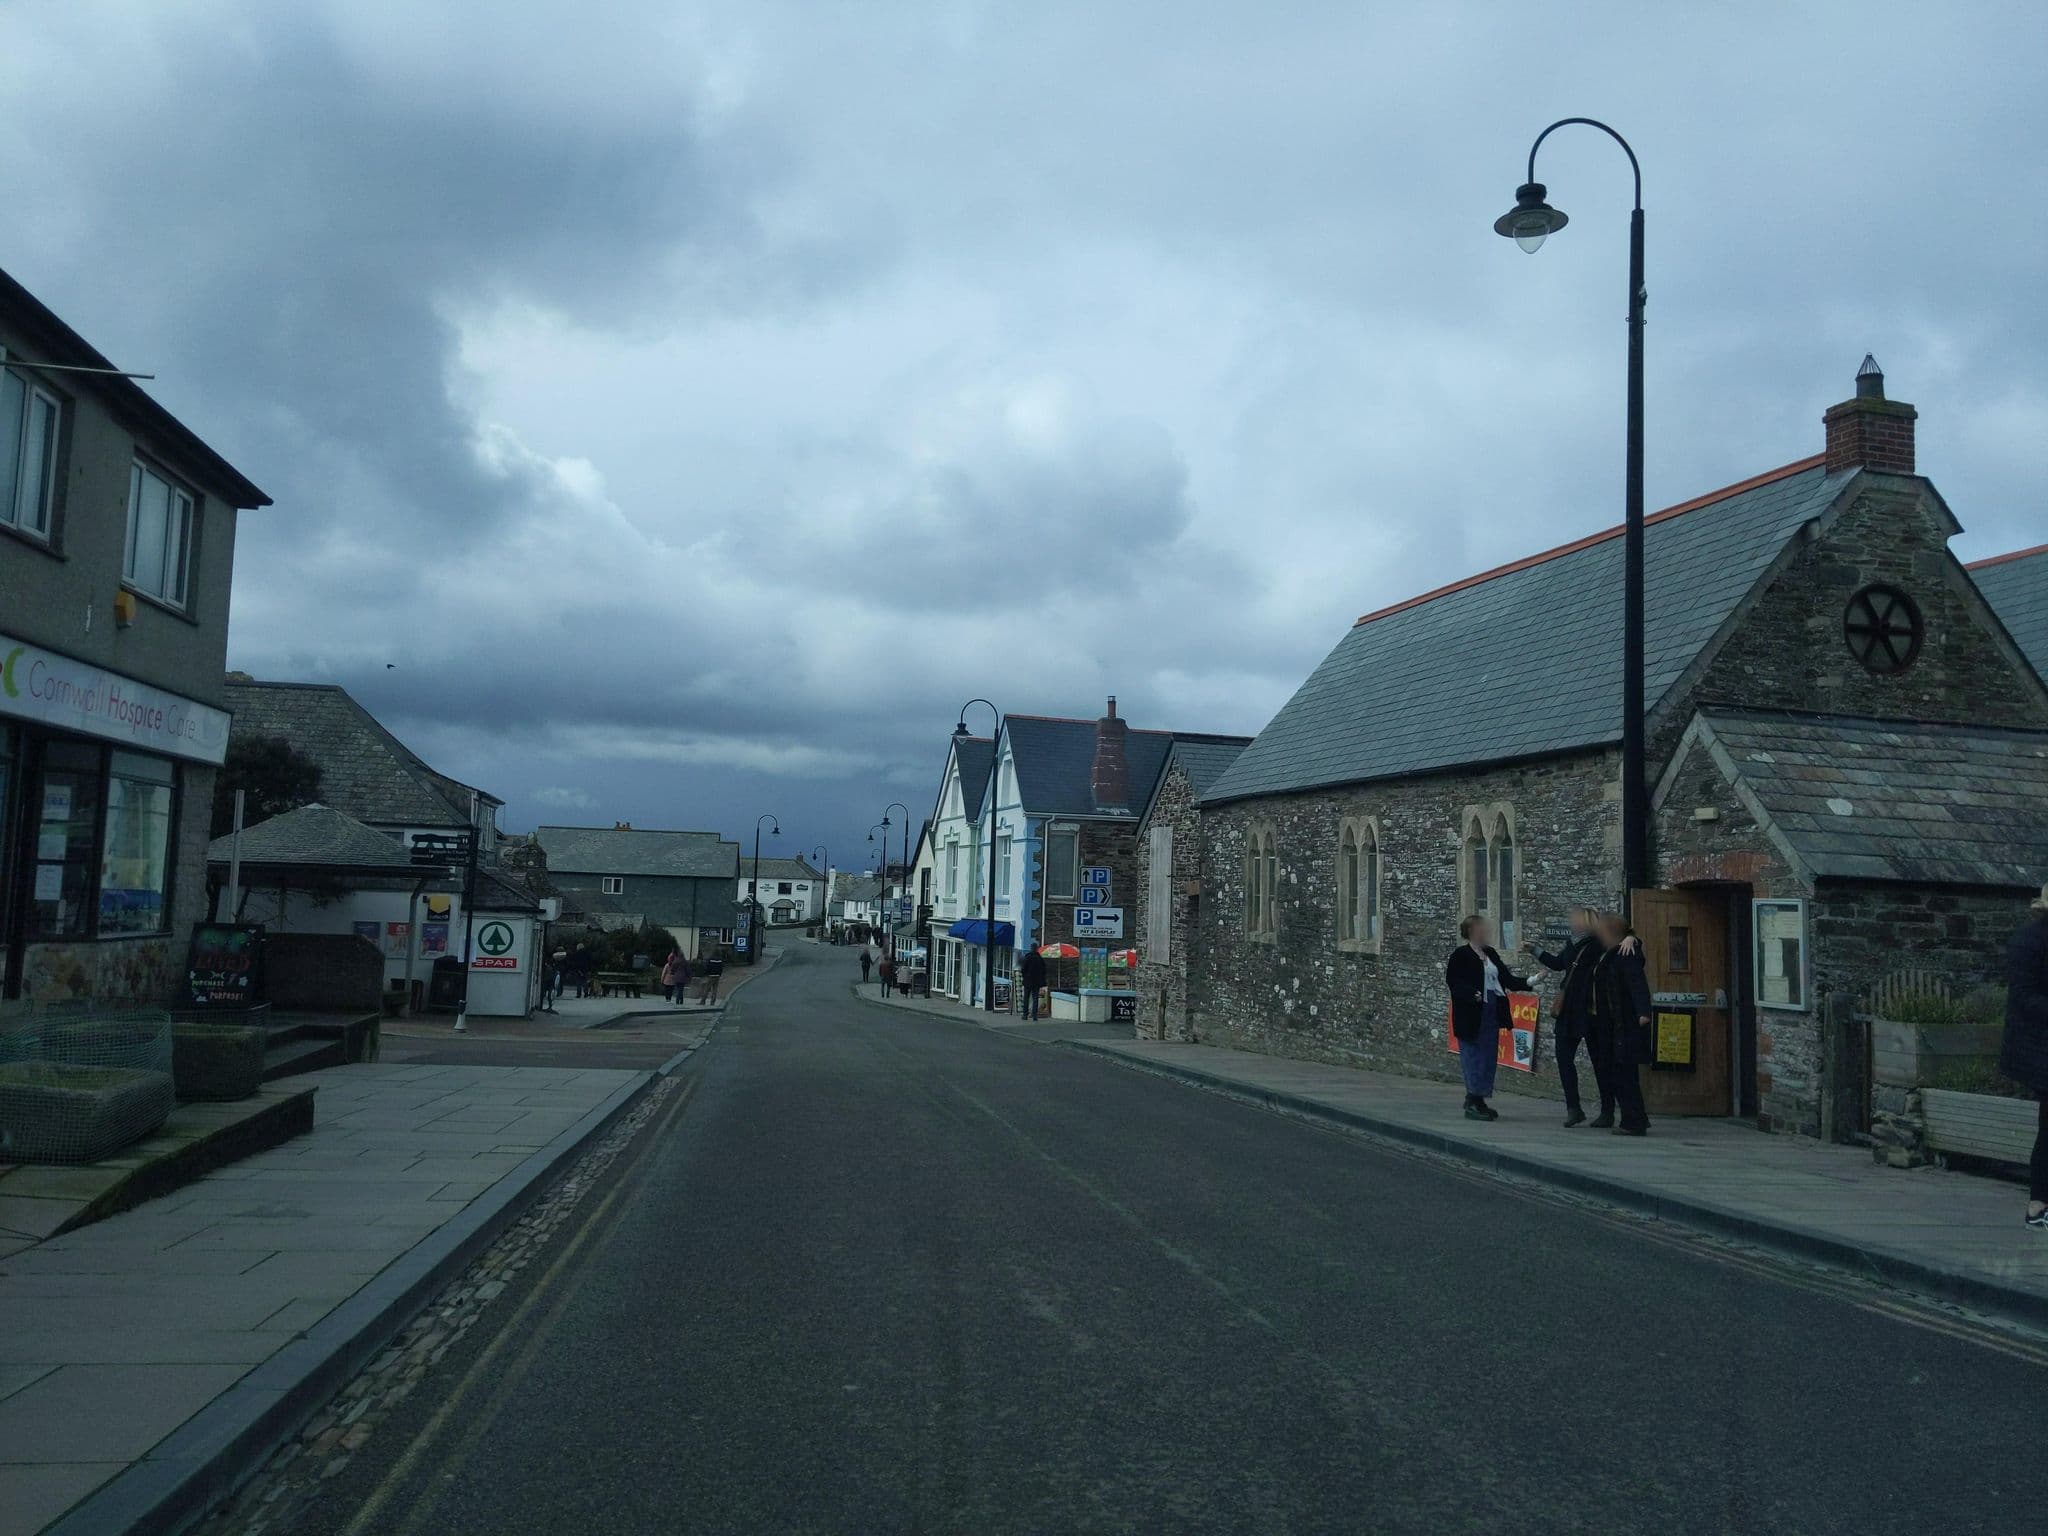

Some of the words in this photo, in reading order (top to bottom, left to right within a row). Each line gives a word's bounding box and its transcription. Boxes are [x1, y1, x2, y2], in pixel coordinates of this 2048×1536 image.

[28, 658, 105, 713] Cornwall
[107, 684, 163, 734] Hospice
[167, 704, 196, 740] Care
[1096, 871, 1105, 882] P
[1087, 890, 1096, 902] P
[1080, 911, 1091, 924] P
[475, 958, 514, 967] SPAR
[1520, 1005, 1538, 1022] CD
